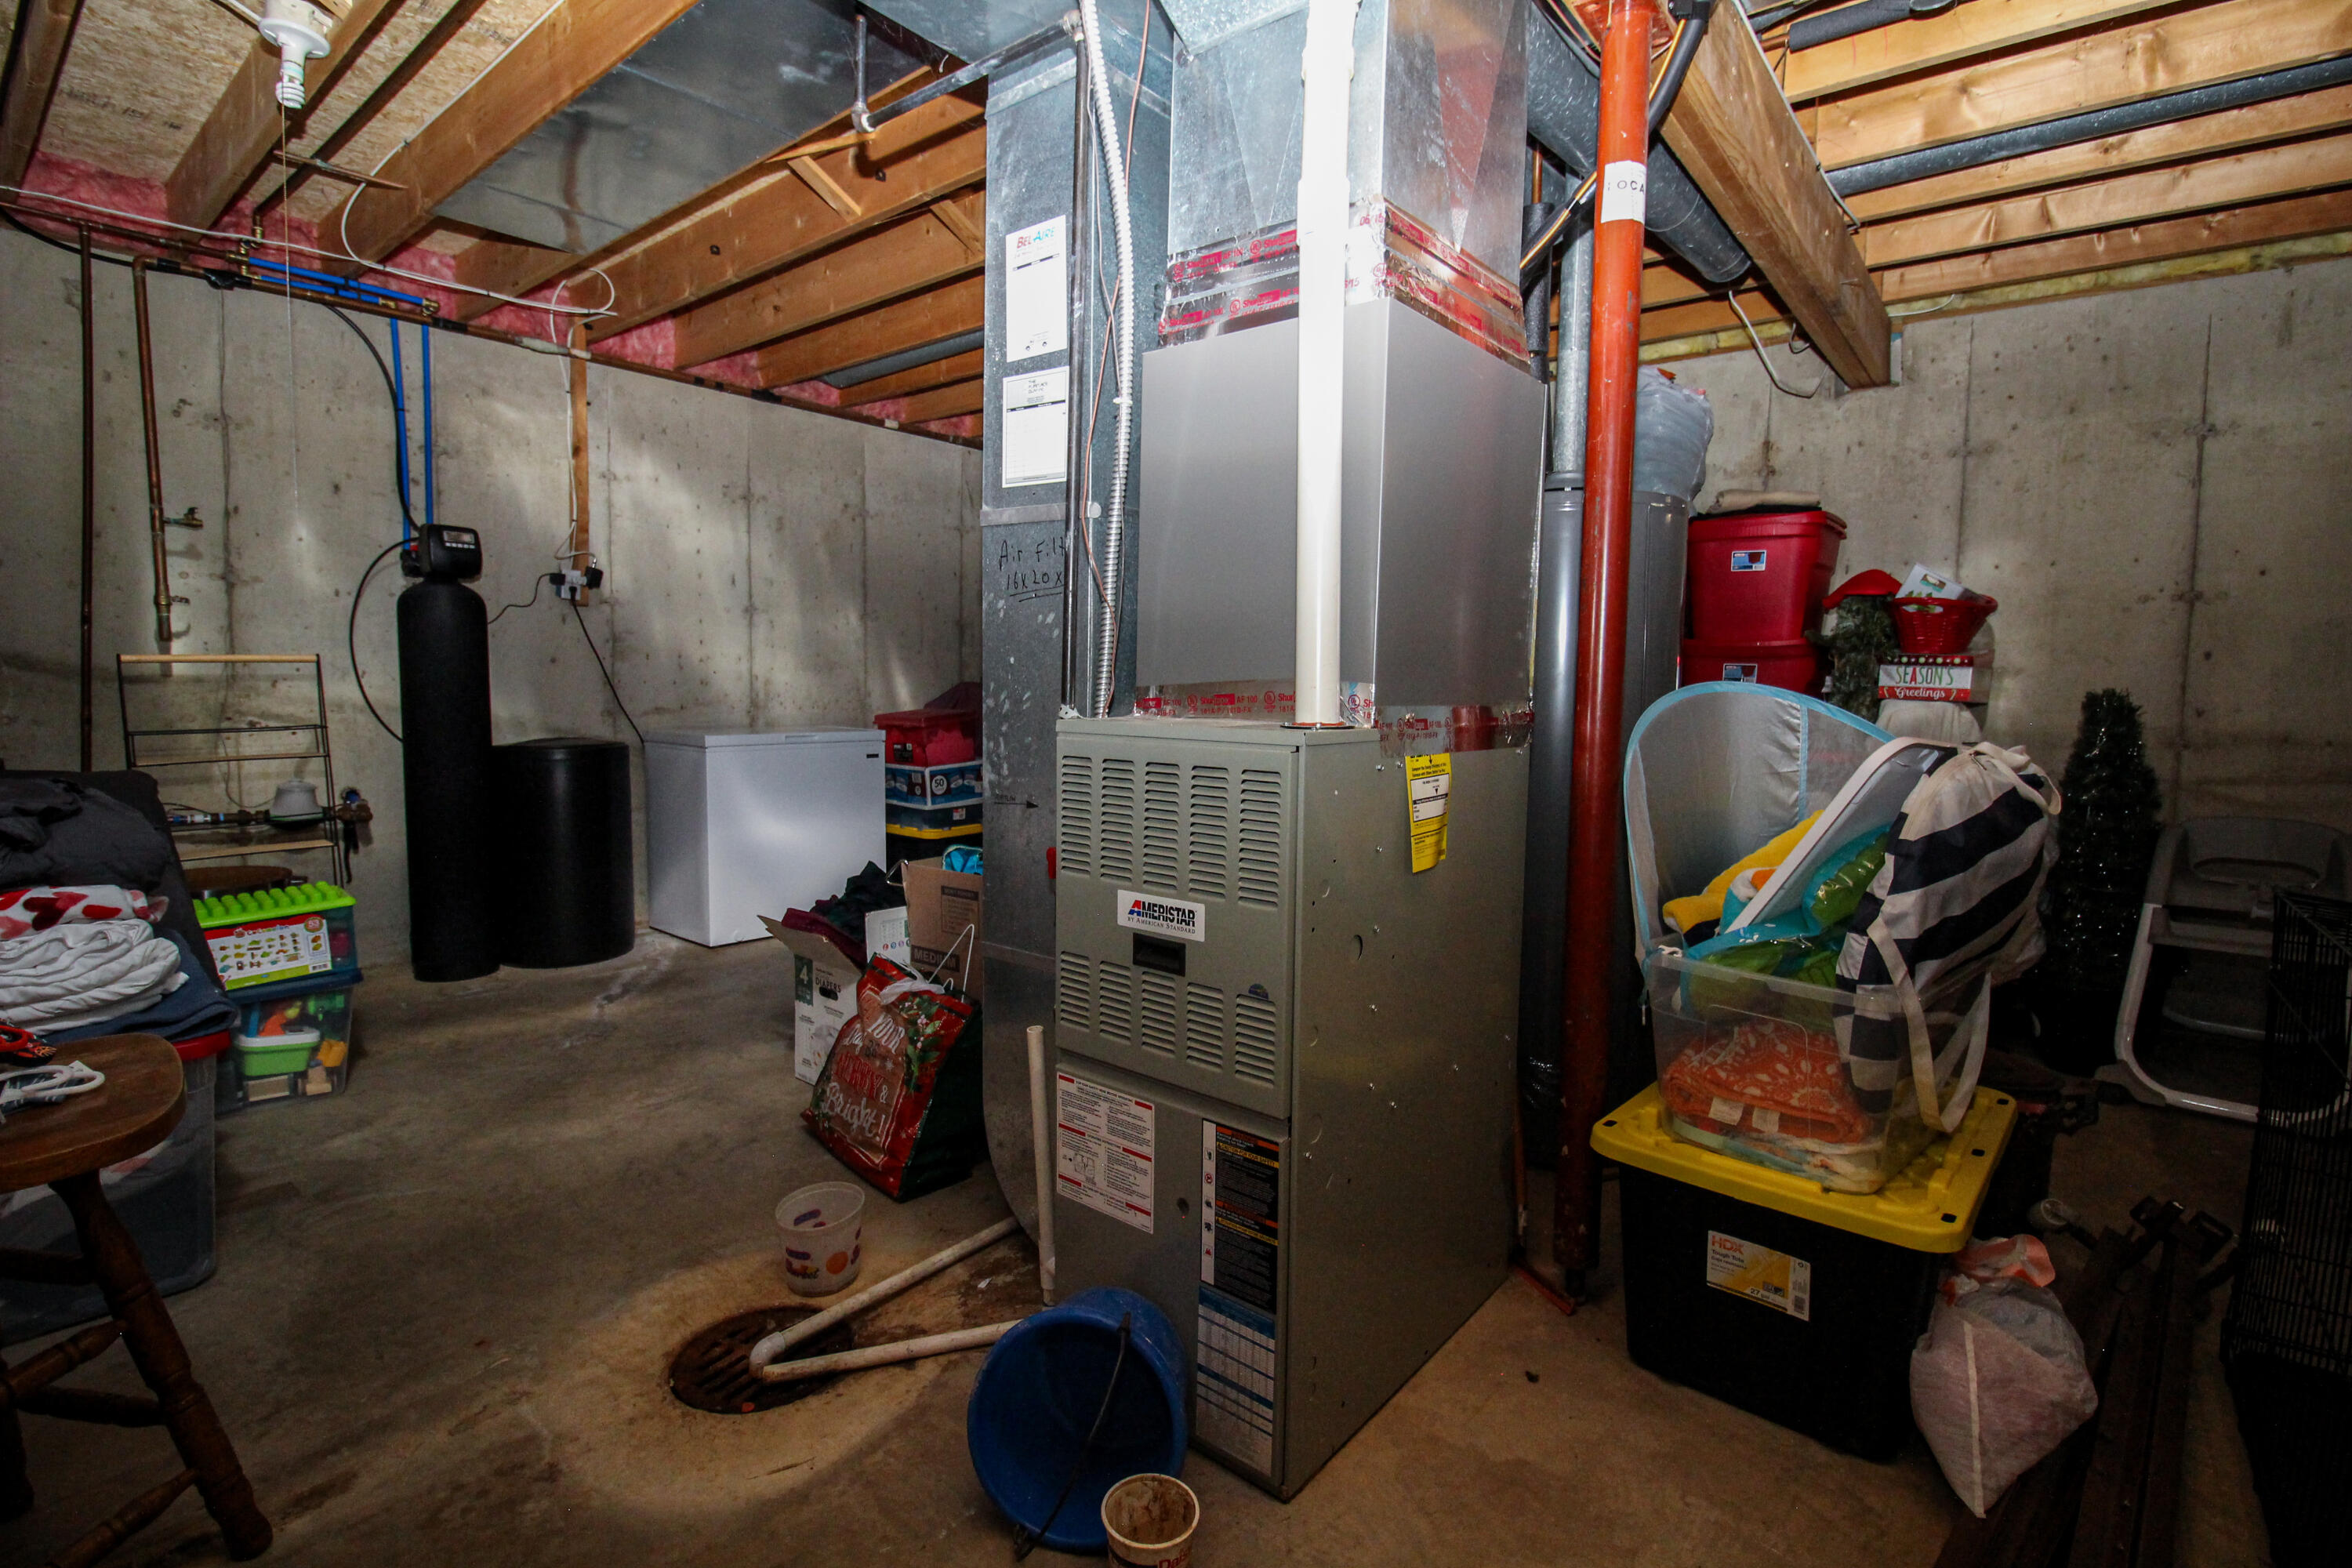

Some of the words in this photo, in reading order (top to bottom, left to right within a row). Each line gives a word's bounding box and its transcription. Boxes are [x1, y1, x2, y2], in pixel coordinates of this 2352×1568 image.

[999, 539, 1023, 571] Air
[1896, 665, 1955, 686] SEASON'S
[1894, 687, 1946, 700] Greetings
[935, 778, 945, 788] 50
[1128, 900, 1196, 927] AMERISTAR
[1136, 917, 1164, 928] AMERICAN
[1166, 923, 1196, 934] STANDARD
[800, 965, 809, 984] 4
[815, 977, 841, 993] DIAPERS
[1712, 1235, 1744, 1255] HDX
[1712, 1249, 1730, 1259] Tough
[1751, 1287, 1760, 1296] 27
